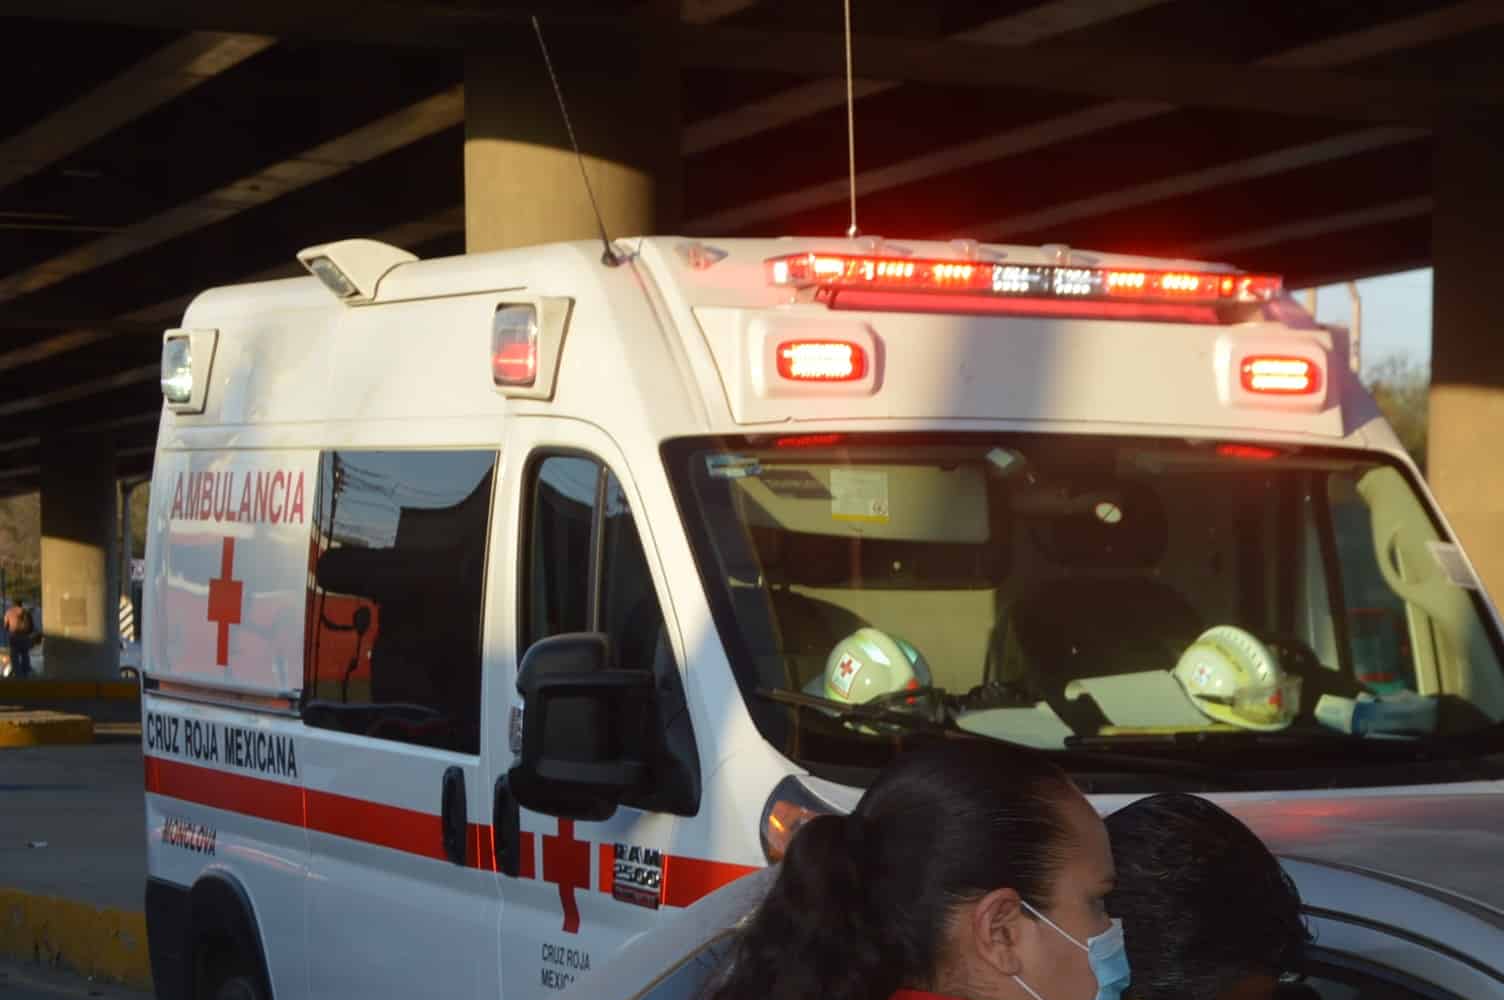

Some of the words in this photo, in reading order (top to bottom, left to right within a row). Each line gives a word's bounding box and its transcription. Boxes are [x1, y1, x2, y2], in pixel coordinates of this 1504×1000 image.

[169, 470, 305, 523] AMBULANCIA
[147, 711, 181, 752] CRUZ
[184, 719, 219, 763] ROJA
[224, 727, 298, 777] MEXICANA
[614, 843, 662, 867] RAM
[542, 943, 565, 966] CRUZ
[566, 949, 591, 971] ROJA
[541, 968, 575, 990] MEXIC
